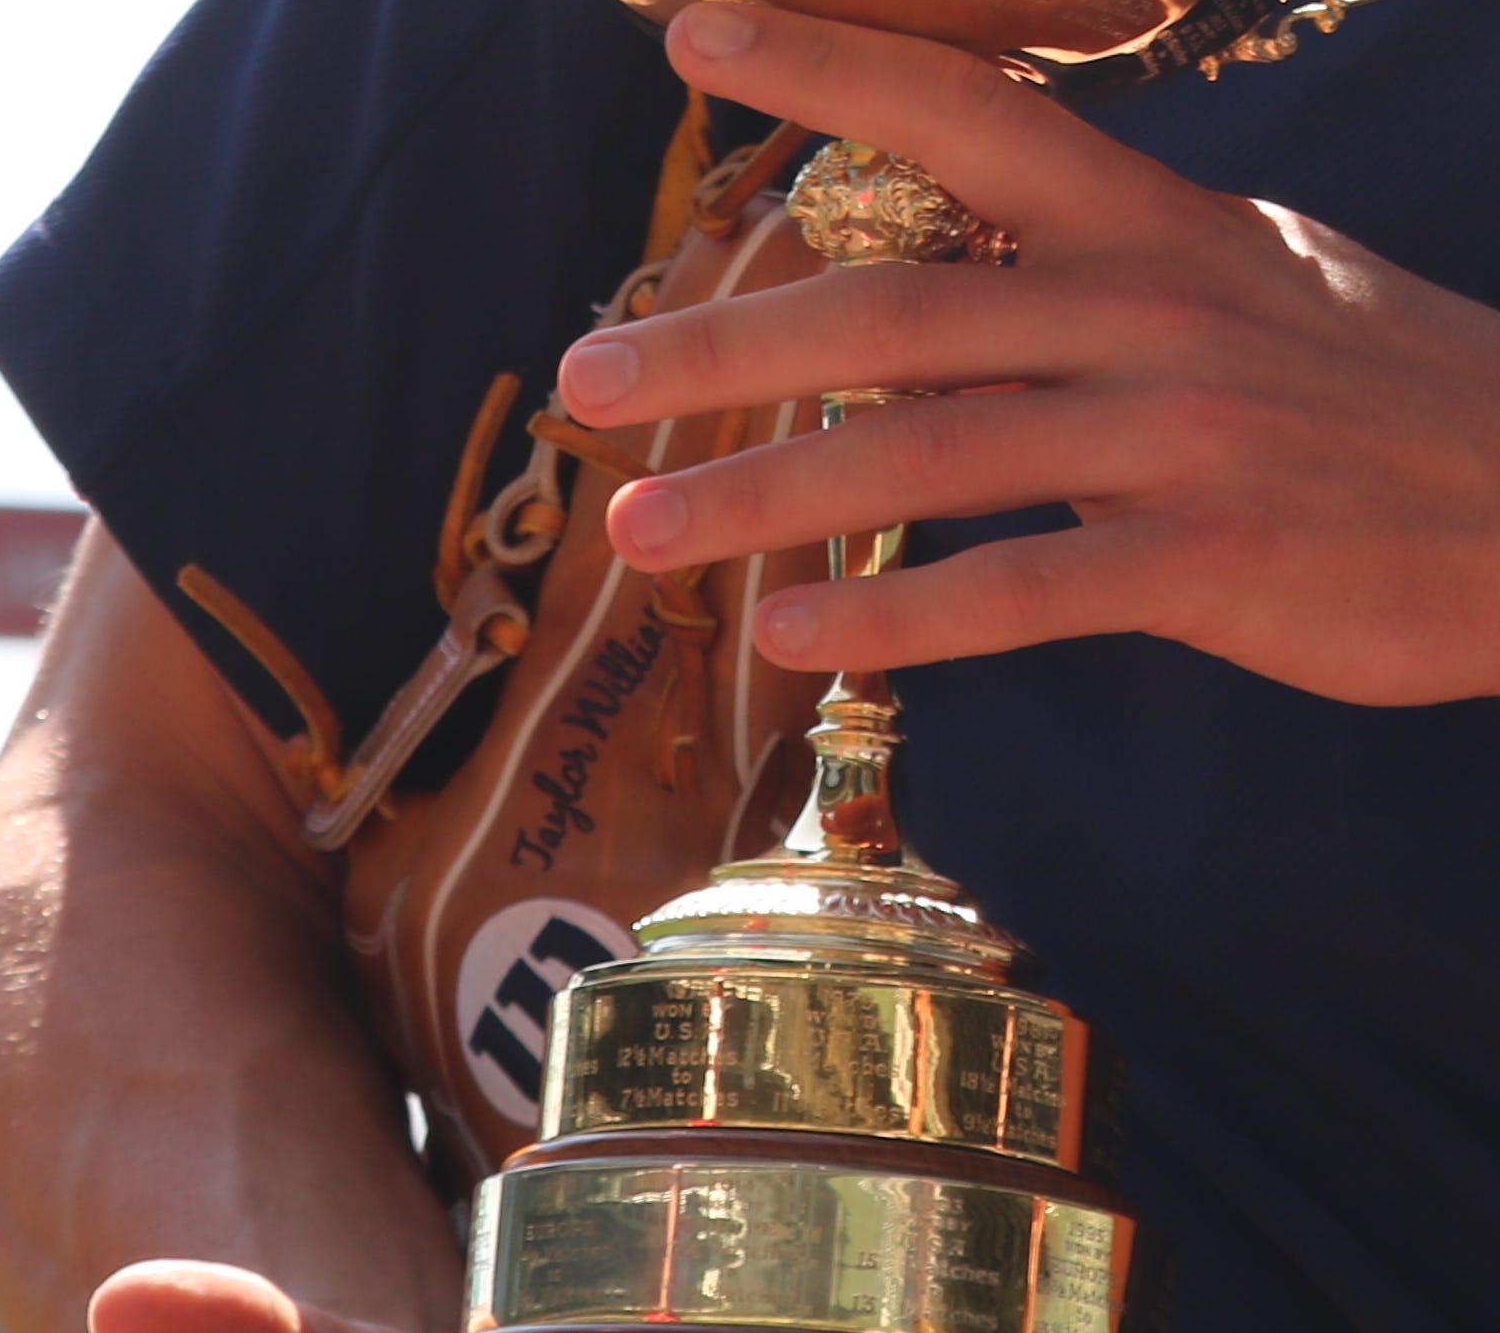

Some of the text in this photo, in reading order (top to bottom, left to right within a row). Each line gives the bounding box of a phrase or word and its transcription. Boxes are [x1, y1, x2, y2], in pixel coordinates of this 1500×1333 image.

[510, 743, 598, 871] Taylor
[652, 1003, 694, 1019] WON
[990, 1033, 1033, 1055] WN
[648, 1045, 740, 1068] Matcs
[670, 1067, 693, 1085] to
[647, 1087, 741, 1108] Matces
